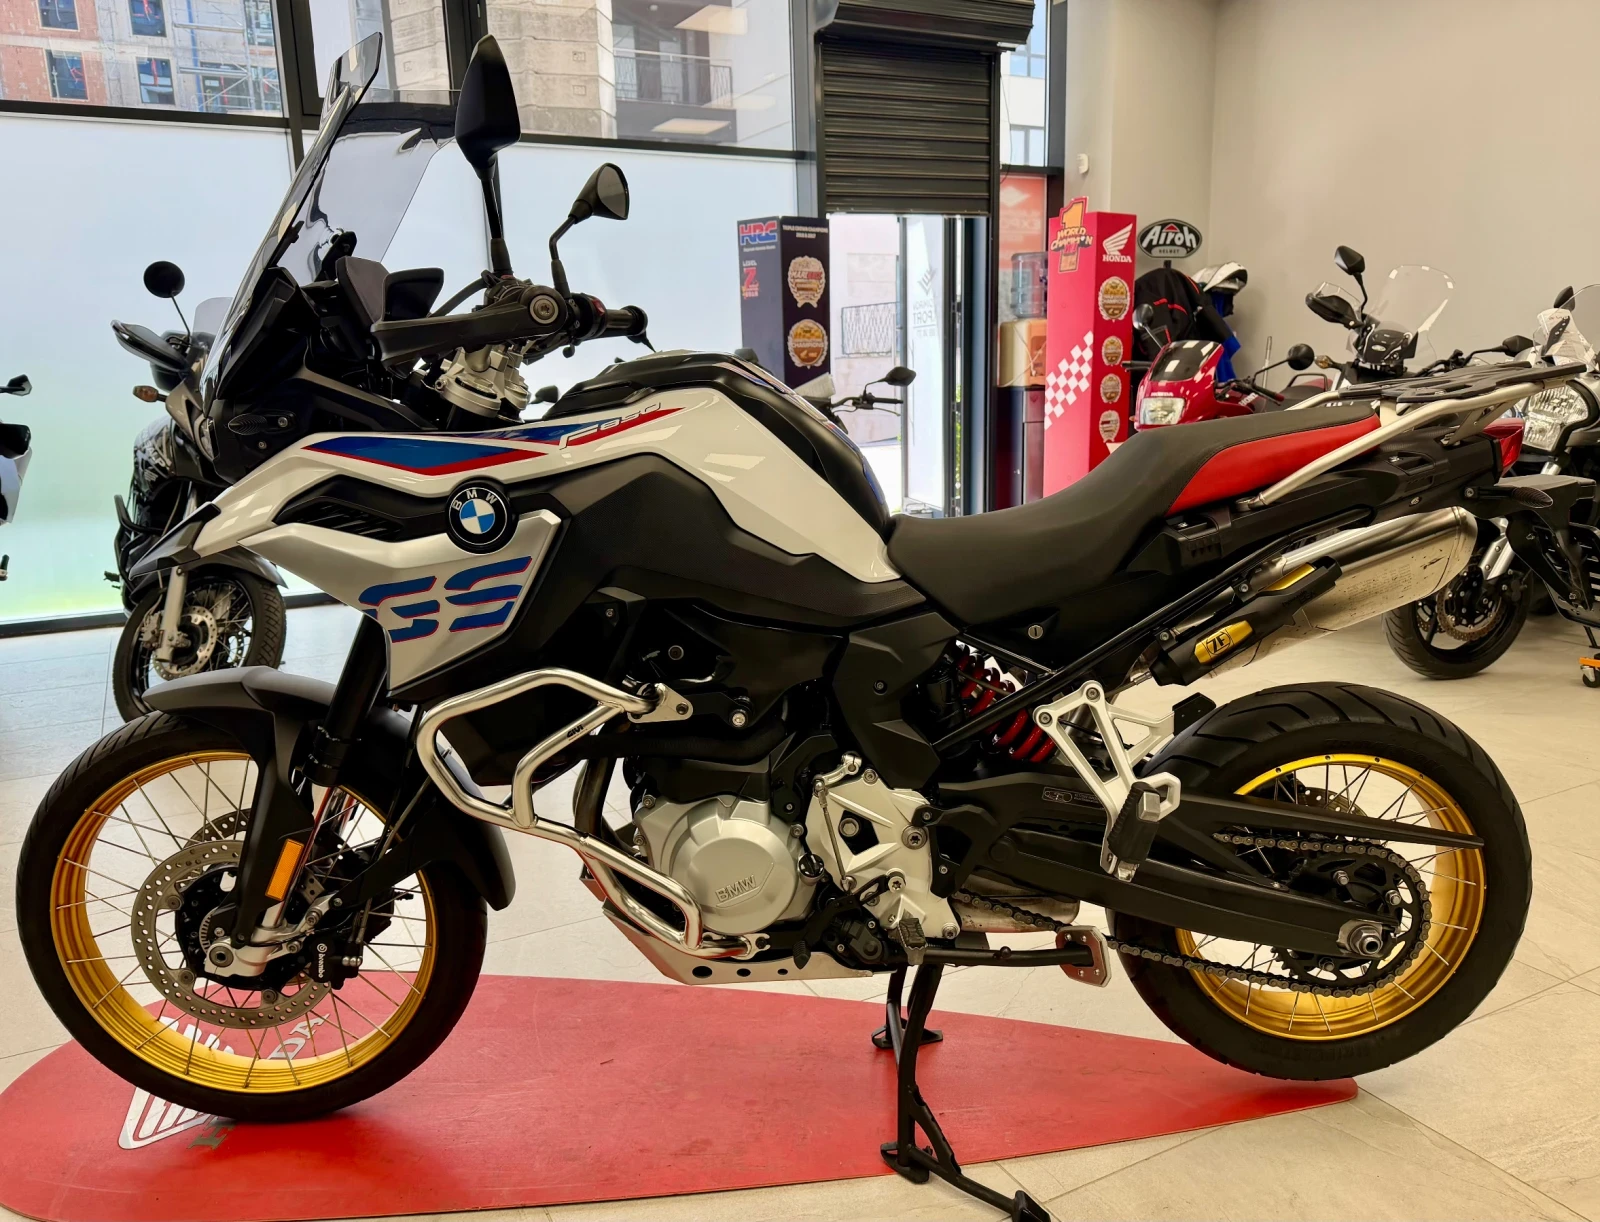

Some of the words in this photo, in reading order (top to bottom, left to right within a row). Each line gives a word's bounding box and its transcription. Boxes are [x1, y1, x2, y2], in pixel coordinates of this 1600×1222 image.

[740, 220, 777, 245] HRC
[1057, 227, 1086, 240] WORLD
[1141, 225, 1197, 248] Airoh
[1102, 254, 1132, 263] HONDA
[451, 489, 498, 511] BMW
[358, 555, 533, 643] GS
[1206, 632, 1228, 654] ZF
[566, 724, 584, 738] GIVI
[715, 874, 757, 903] BMW
[318, 953, 326, 979] brembo
